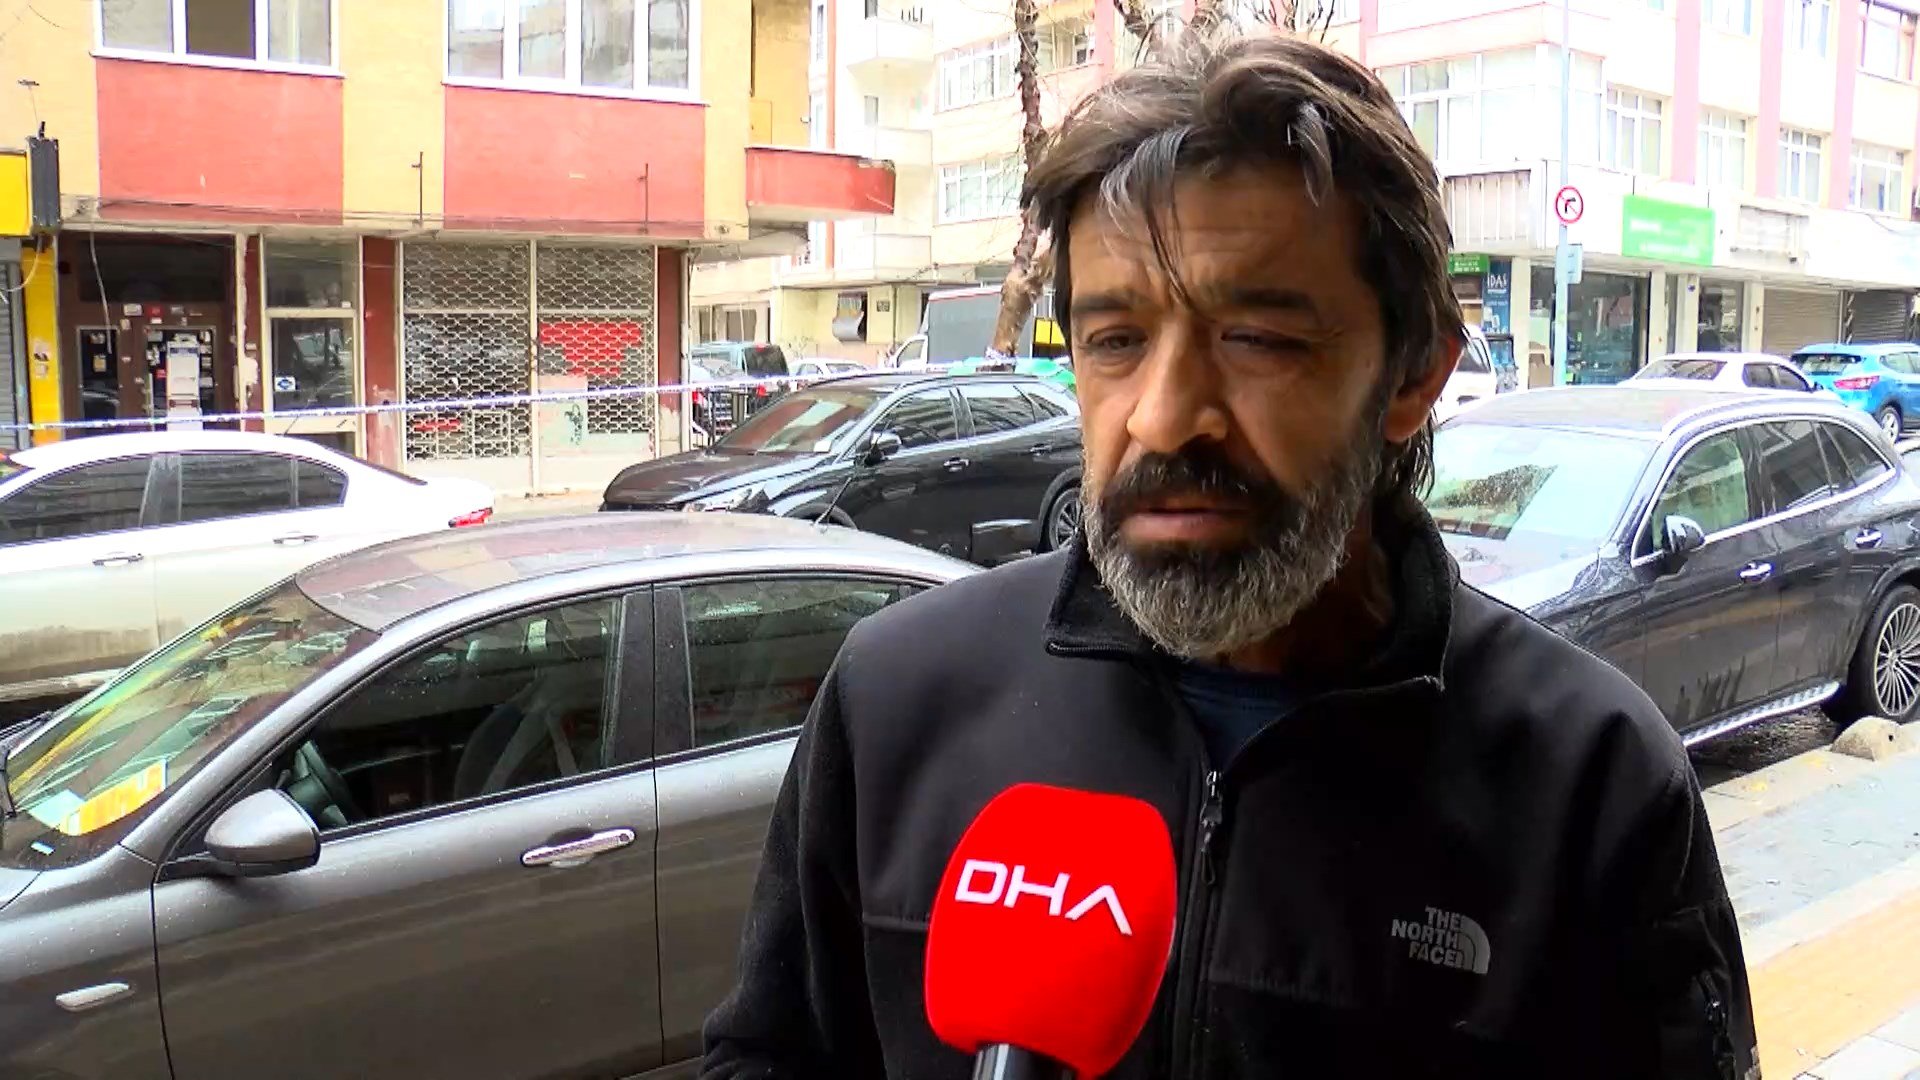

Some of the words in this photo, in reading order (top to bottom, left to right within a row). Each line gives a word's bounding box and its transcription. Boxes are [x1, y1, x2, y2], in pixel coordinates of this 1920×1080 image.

[955, 859, 1132, 936] DHA
[1425, 906, 1460, 931] THE
[1391, 919, 1458, 949] NORTH
[1408, 941, 1457, 968] FACE
